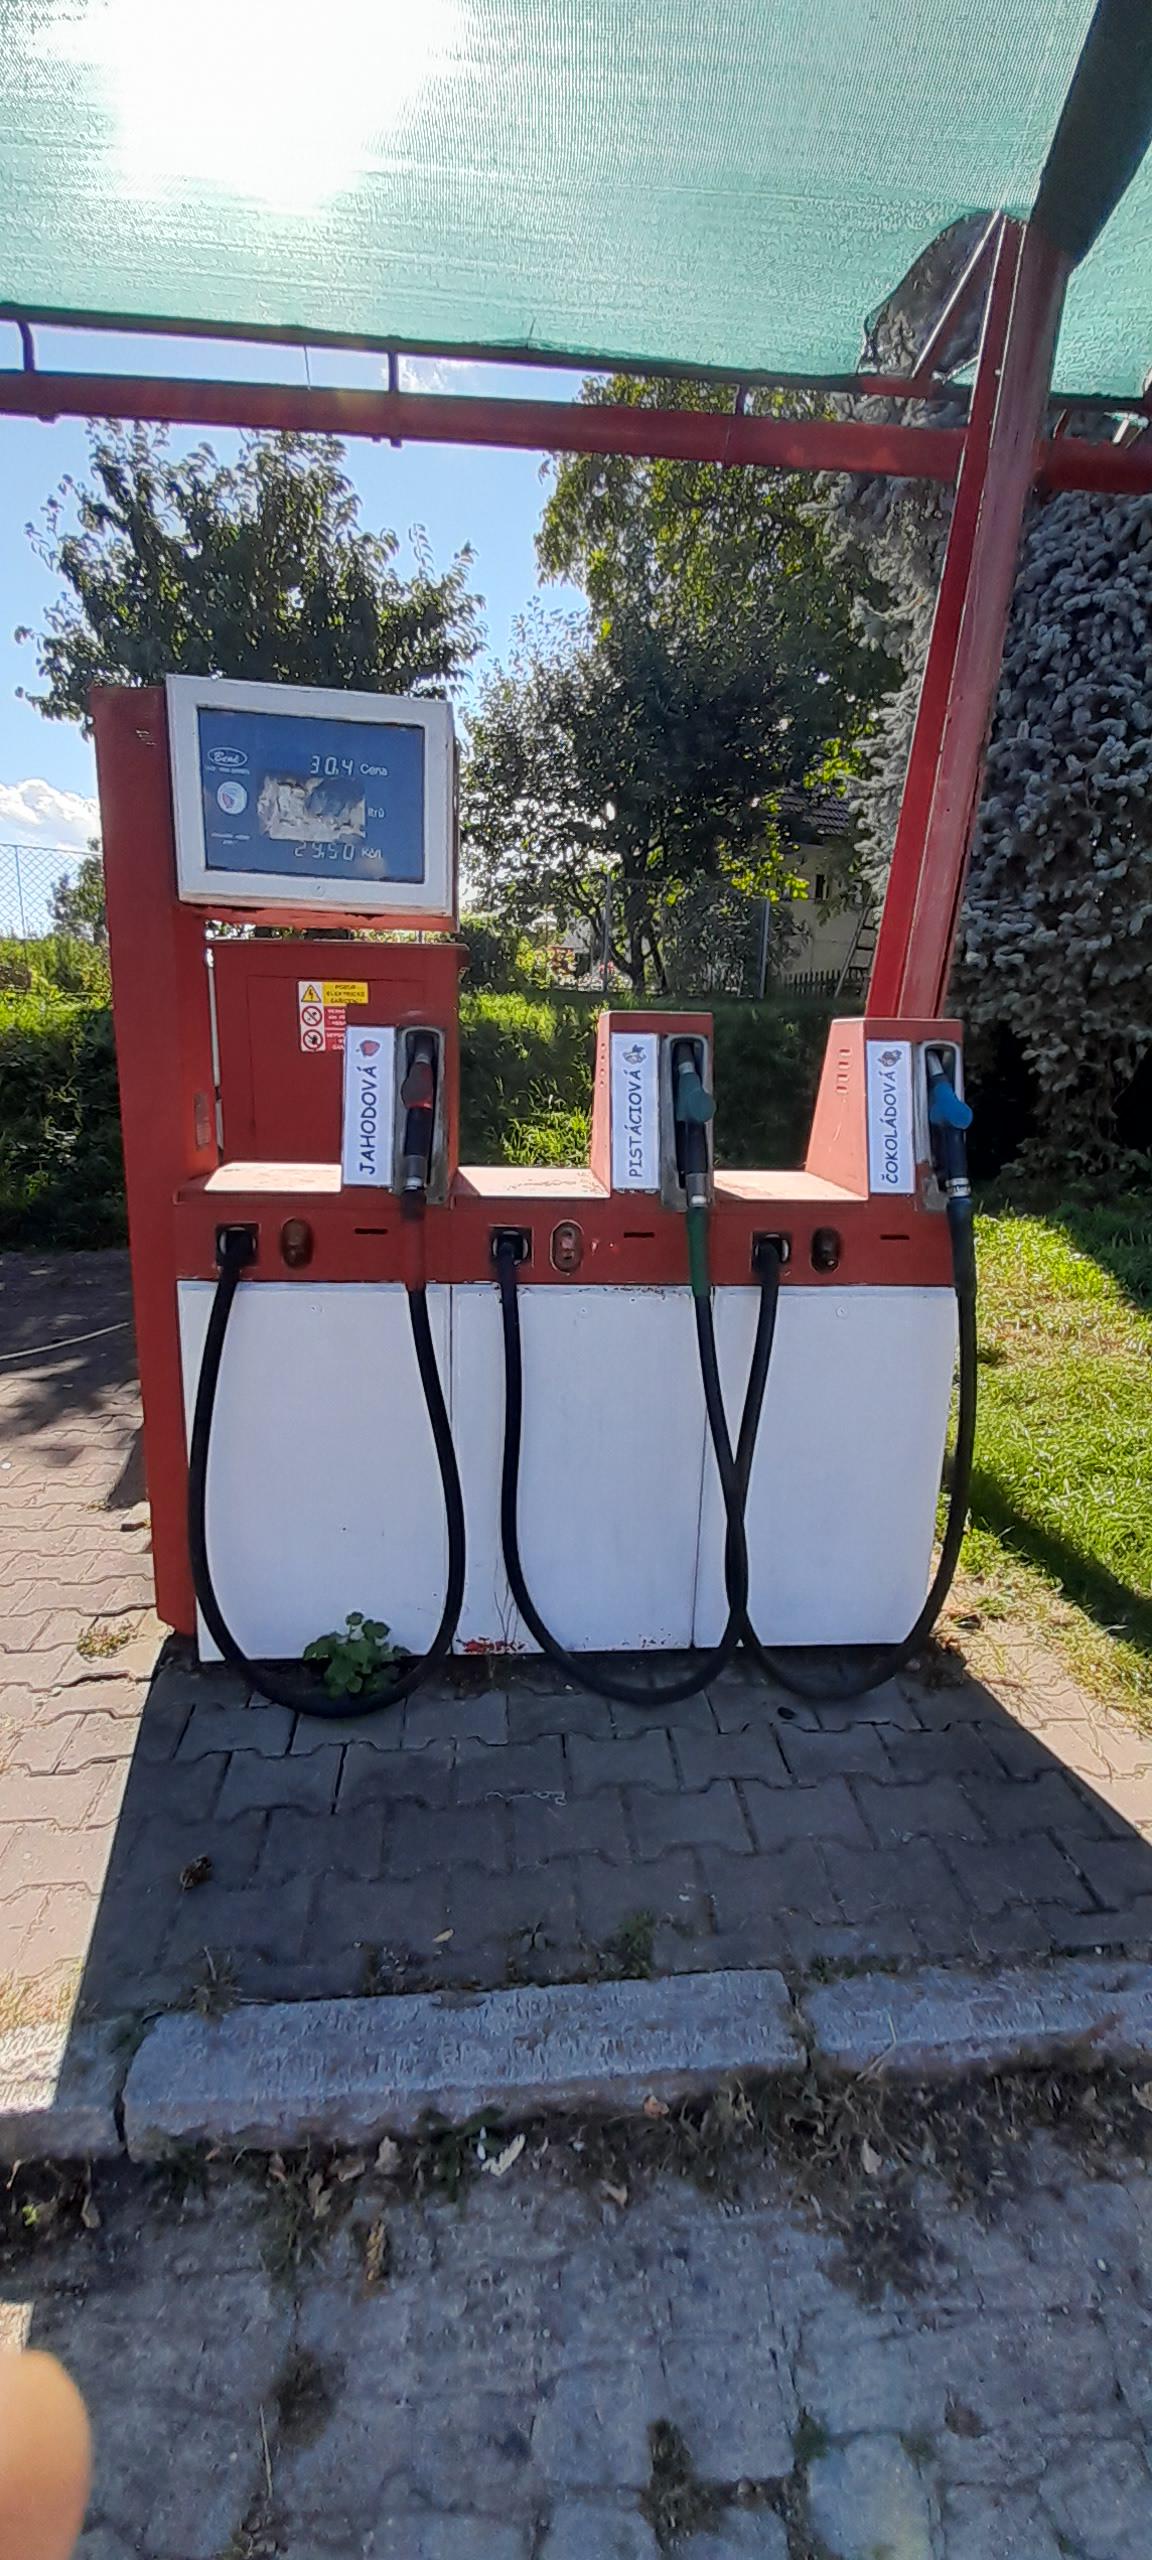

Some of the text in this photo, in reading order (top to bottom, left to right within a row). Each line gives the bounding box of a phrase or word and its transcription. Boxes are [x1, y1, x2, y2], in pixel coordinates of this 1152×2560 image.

[360, 763, 388, 777] Cena
[356, 1066, 377, 1175] JAHODOVÁ
[624, 1069, 643, 1178] PISTÁCIOVÁ
[878, 1070, 899, 1185] ČOKOLÁDOVÁ
